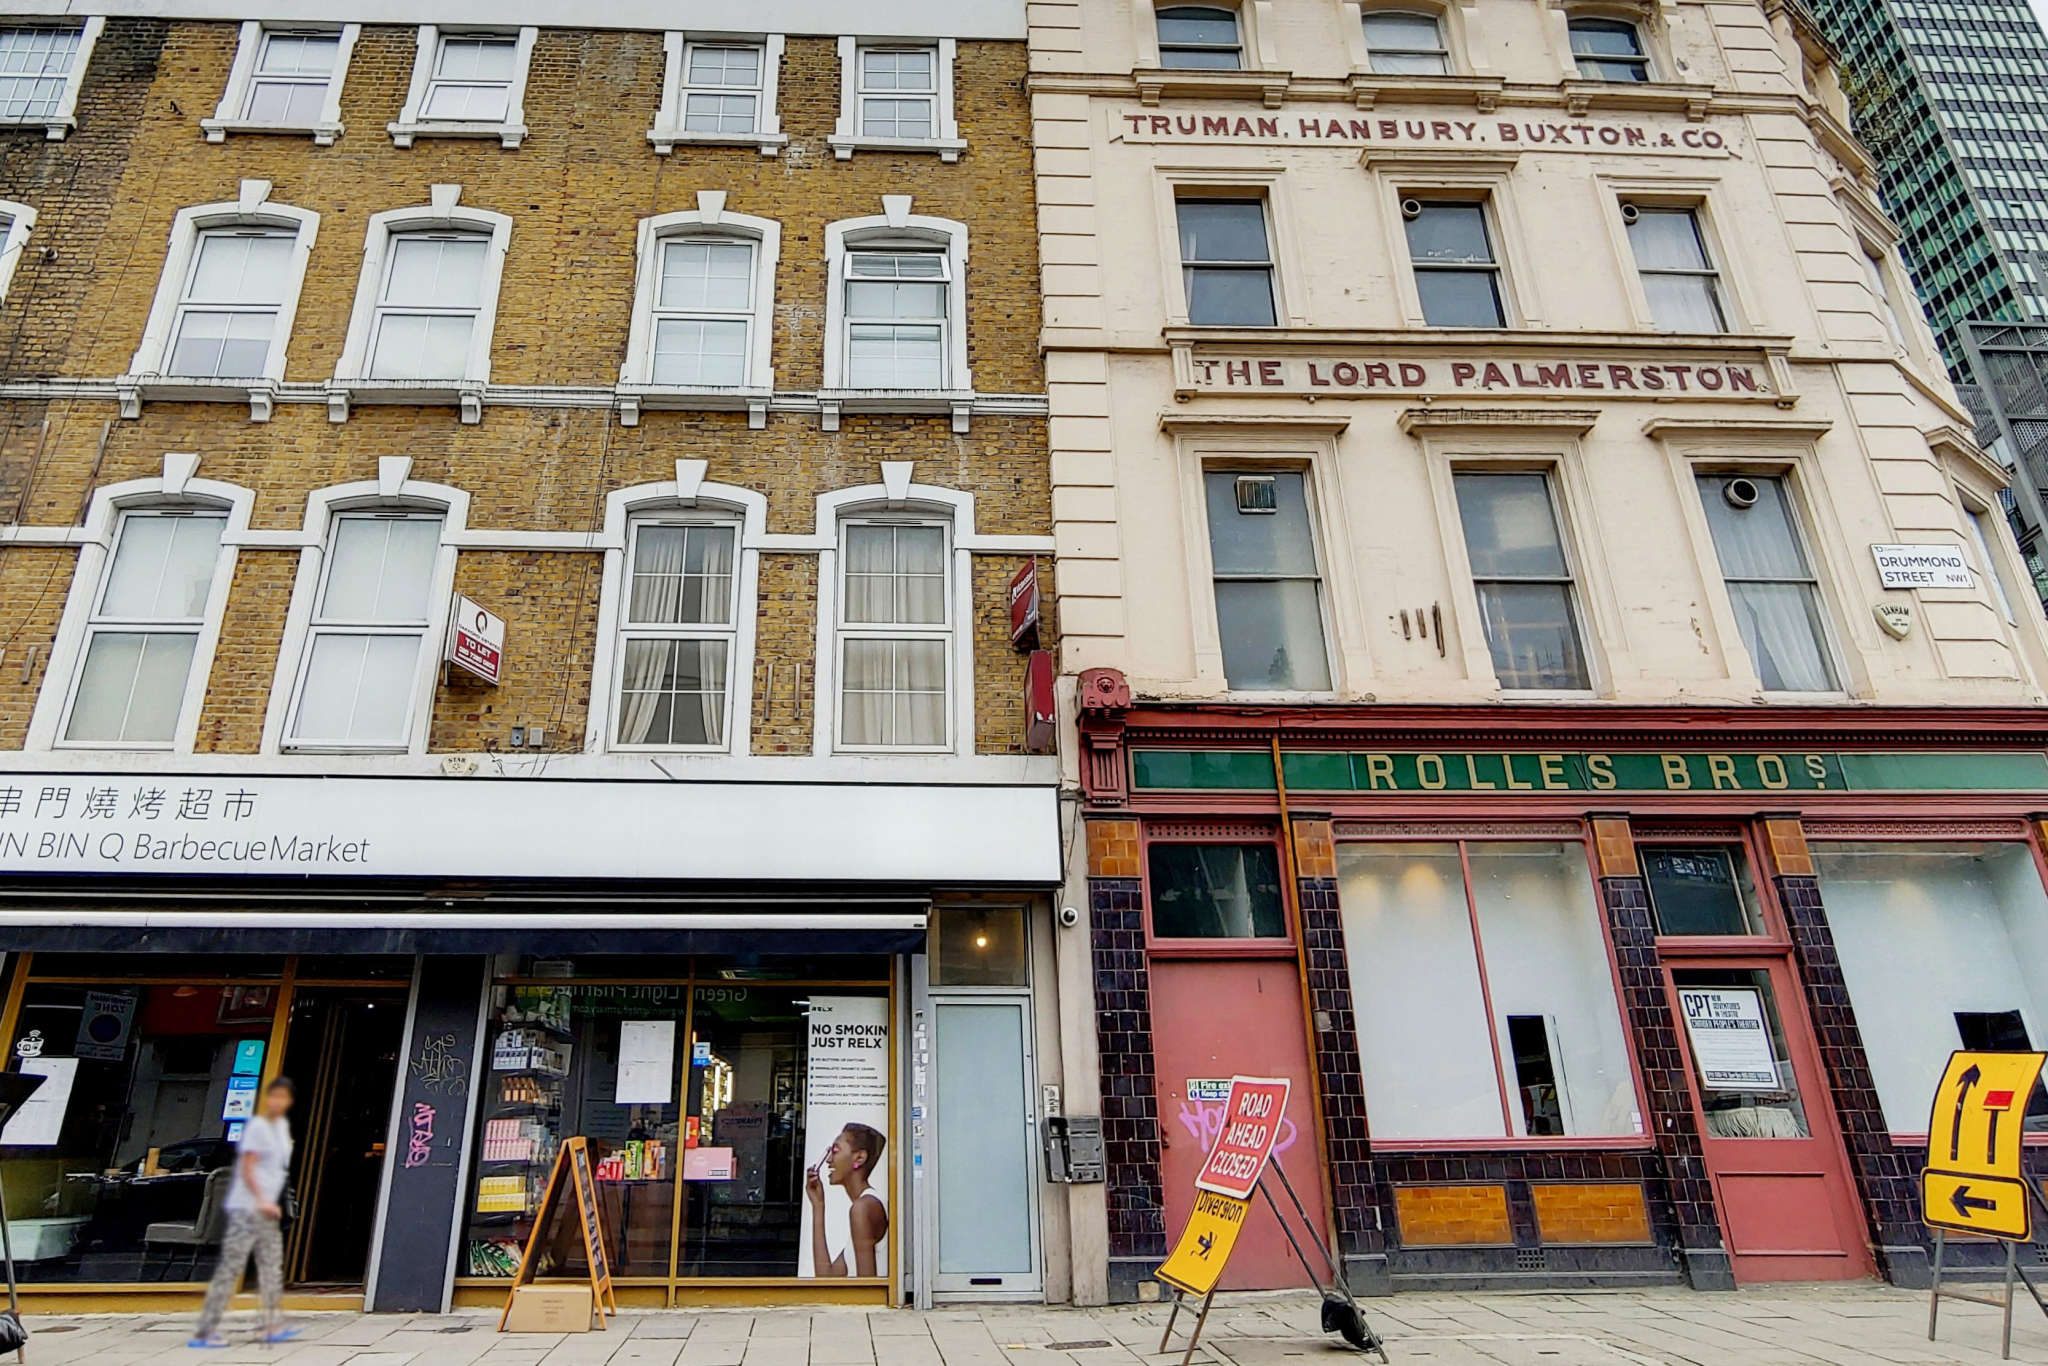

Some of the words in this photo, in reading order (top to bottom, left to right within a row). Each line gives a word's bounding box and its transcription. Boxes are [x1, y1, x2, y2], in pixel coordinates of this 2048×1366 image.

[1660, 132, 1677, 147] &
[1193, 360, 1284, 386] THE
[1307, 361, 1427, 388] LORD
[1451, 362, 1758, 391] PALMERSTON
[1879, 556, 1961, 568] DRUMMOND
[1884, 571, 1935, 582] STREET
[1945, 574, 1968, 583] NW1
[465, 637, 476, 650] TO
[477, 642, 492, 658] LET
[1366, 754, 1617, 791] ROLLES
[37, 832, 89, 859] BIN
[99, 832, 125, 862] Q
[1684, 994, 1713, 1018] CPT
[811, 1024, 832, 1035] NO
[811, 1037, 844, 1048] JUST
[847, 1038, 882, 1049] RELX
[1200, 1080, 1217, 1090] Fire
[1237, 1092, 1273, 1118] ROAD
[1225, 1122, 1267, 1149] AHEAD
[1210, 1150, 1258, 1180] CLOSED
[1198, 1190, 1243, 1223] Diversion
